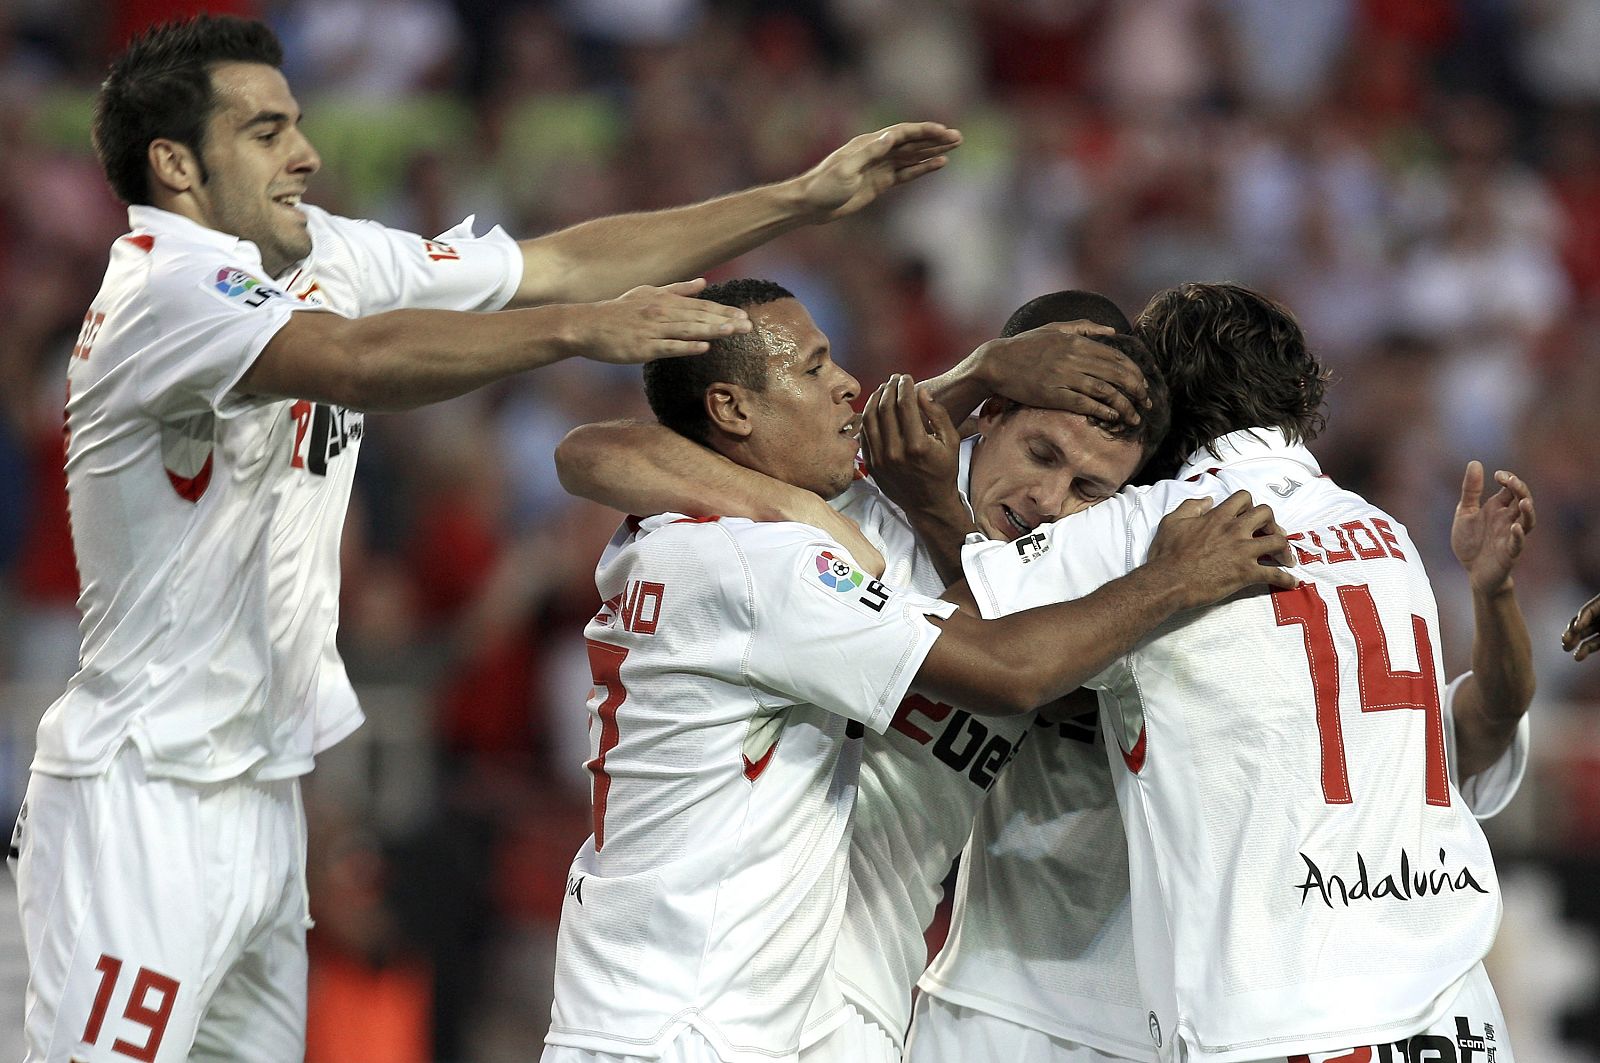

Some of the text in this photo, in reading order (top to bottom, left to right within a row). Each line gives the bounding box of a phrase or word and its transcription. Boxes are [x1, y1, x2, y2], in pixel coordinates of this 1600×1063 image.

[1286, 517, 1408, 566] CUDE
[1268, 580, 1450, 807] 14
[80, 952, 181, 1063] 19
